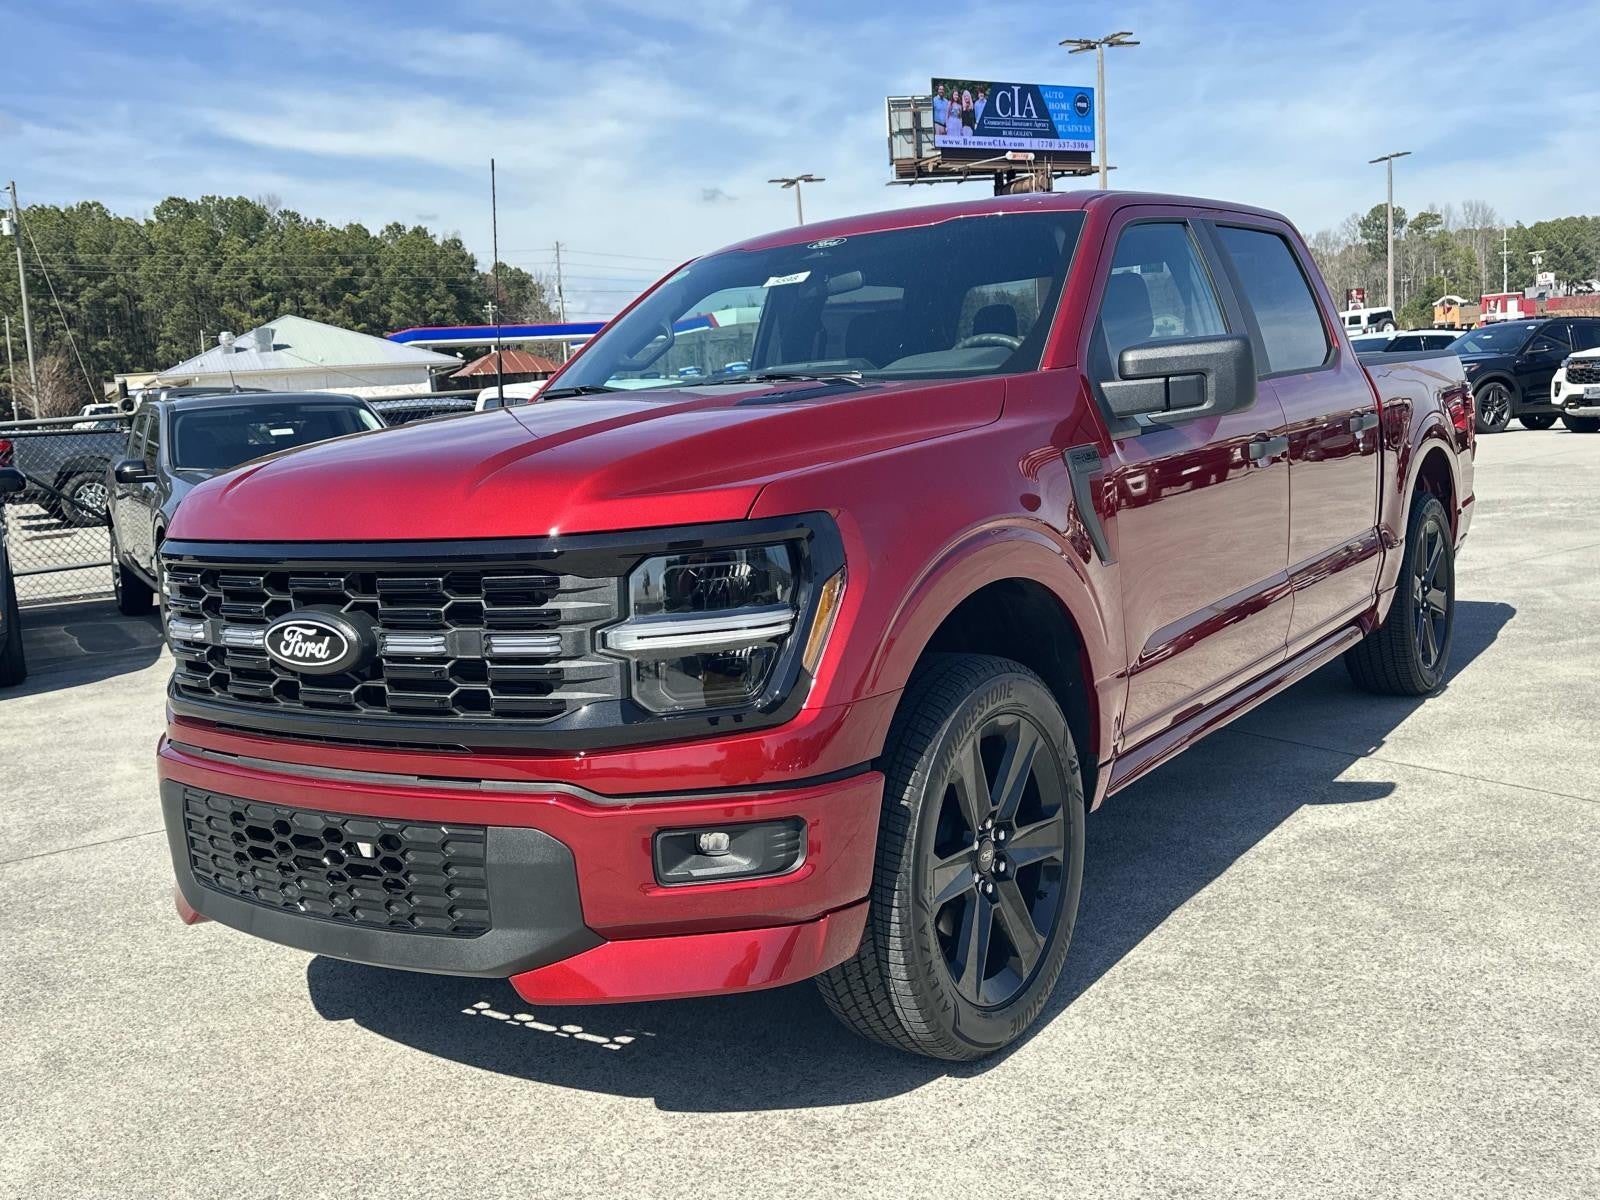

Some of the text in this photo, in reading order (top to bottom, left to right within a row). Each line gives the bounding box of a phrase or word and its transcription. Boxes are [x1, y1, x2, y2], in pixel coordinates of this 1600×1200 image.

[1044, 91, 1064, 99] AUTO
[995, 86, 1038, 118] CIA
[1048, 102, 1071, 110] HOME
[1053, 113, 1070, 121] LIFE
[1034, 121, 1049, 129] Agency
[1058, 124, 1092, 133] BUSINESS
[942, 138, 1025, 148] www.BremenCIA.com
[1037, 140, 1056, 148] (770)
[280, 626, 330, 659] Ford
